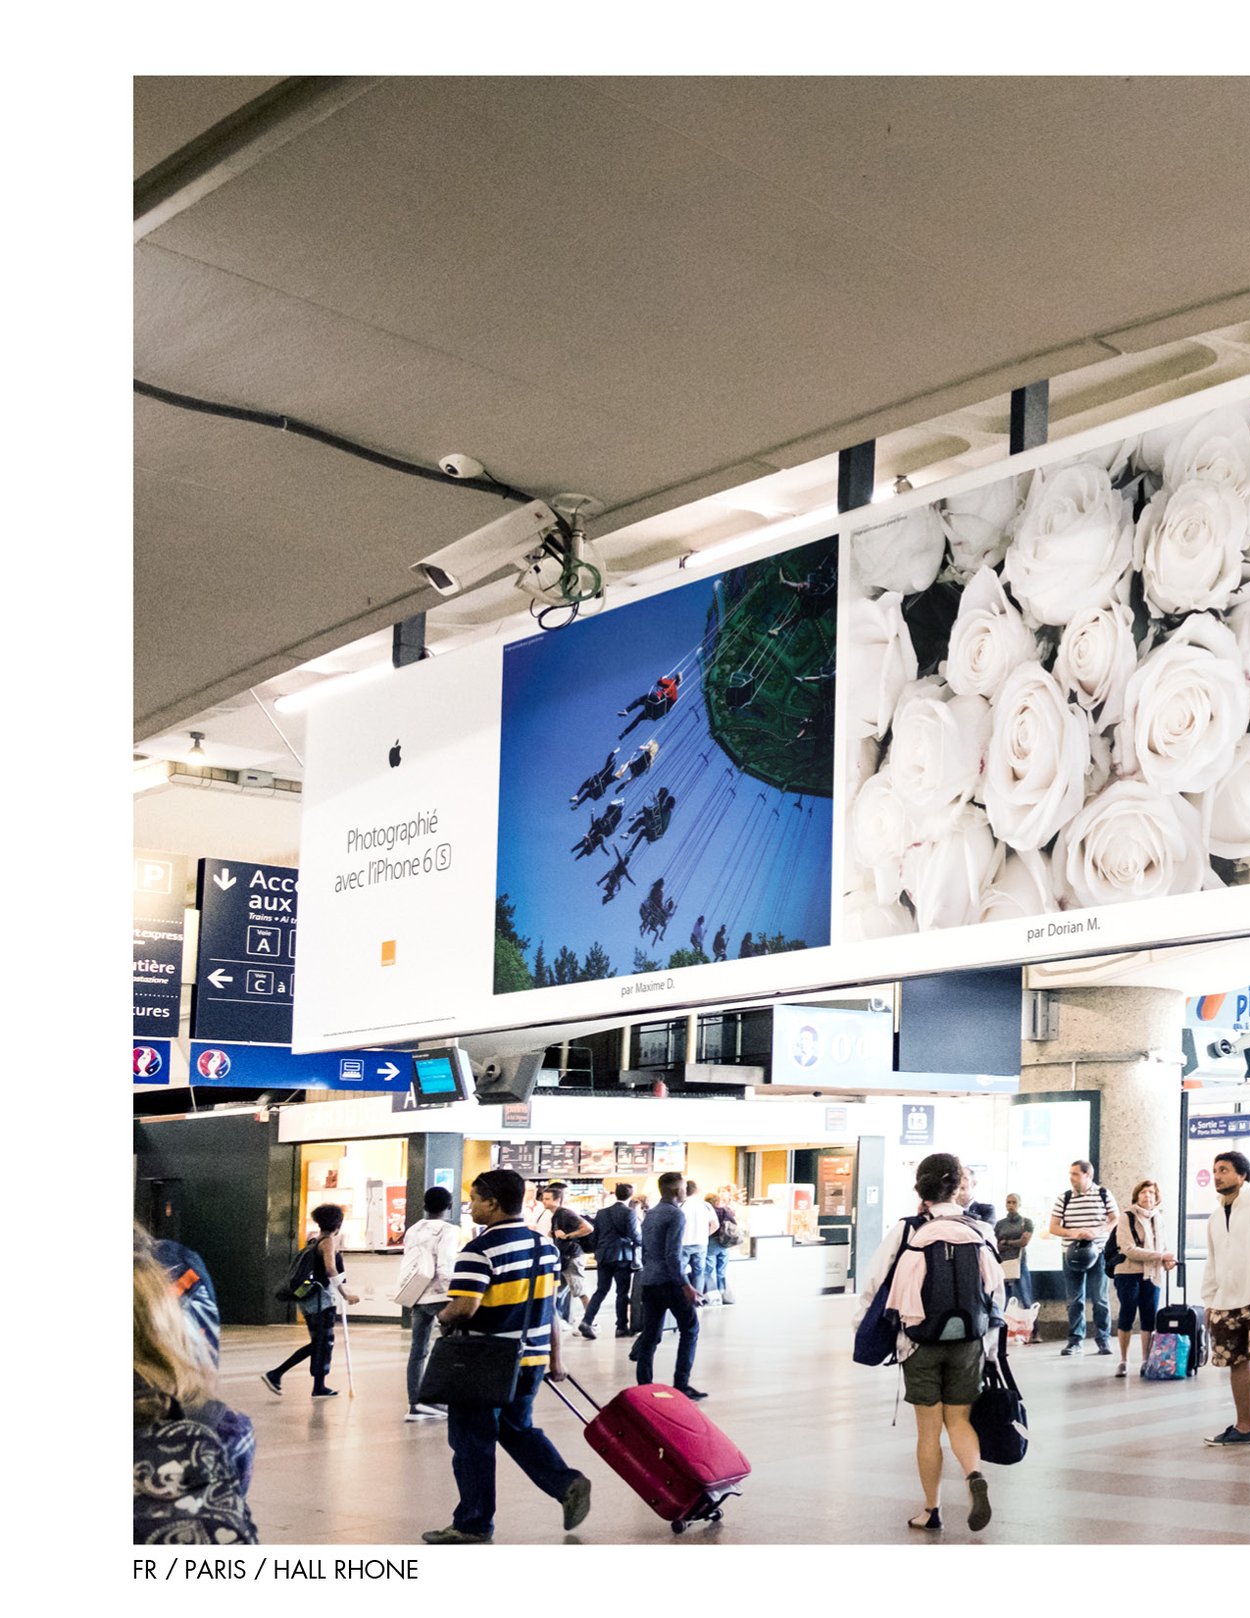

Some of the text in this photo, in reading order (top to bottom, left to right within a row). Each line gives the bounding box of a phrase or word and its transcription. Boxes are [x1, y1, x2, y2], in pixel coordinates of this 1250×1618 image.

[347, 808, 438, 854] Photographié
[143, 864, 164, 887] P
[334, 869, 365, 893] avec
[423, 848, 433, 873] 6
[248, 894, 292, 912] aux
[248, 912, 273, 922] Trains
[1027, 917, 1100, 943] par Dorian M.
[256, 938, 271, 953] A
[254, 979, 286, 993] C à
[621, 978, 675, 998] par Maxime D.
[1197, 1120, 1218, 1129] Sortie
